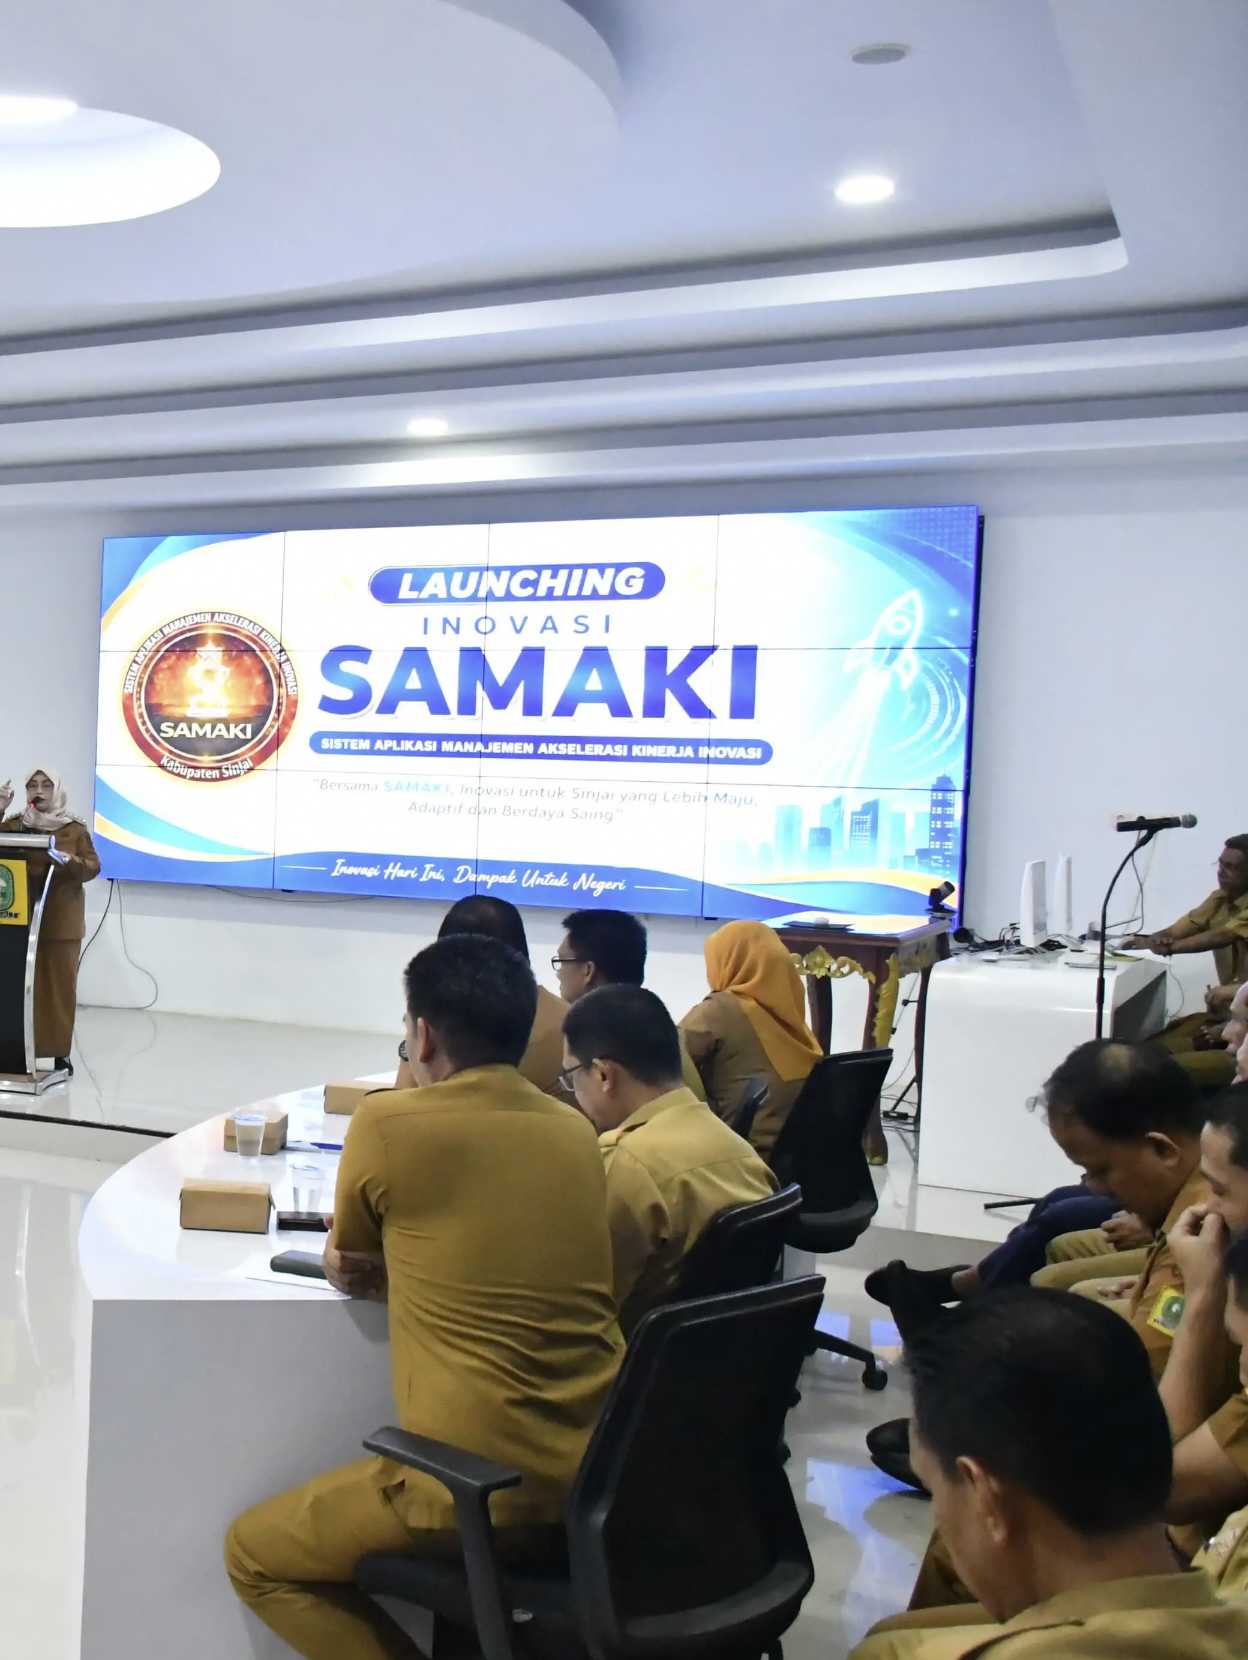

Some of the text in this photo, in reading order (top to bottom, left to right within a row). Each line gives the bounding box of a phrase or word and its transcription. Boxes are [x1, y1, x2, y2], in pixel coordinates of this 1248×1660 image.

[398, 567, 646, 599] LAUNCHING
[423, 615, 610, 635] INOVASI
[135, 629, 164, 662] APLIKASI
[161, 612, 212, 635] MANAJEMEN
[213, 612, 262, 635] AKSELERASI
[318, 645, 758, 719] SAMAKI
[160, 722, 252, 739] SAMAKI
[320, 738, 762, 759] SISTEM APLIKASI MANAJEMEN AKSELERASI KINERJA INOVASI
[160, 756, 253, 779] Kabupaten Sinjai
[460, 784, 514, 797] Inovasi
[519, 786, 564, 800] untuk
[572, 787, 614, 803] Sinjai
[620, 792, 657, 805] yang
[663, 789, 709, 803] Lebih
[408, 801, 463, 816] Adaptif
[468, 803, 497, 816] dan
[502, 805, 564, 821] Berdaya
[331, 858, 626, 897] Inovasi Hari Ini, Dampak Untuk Negeri
